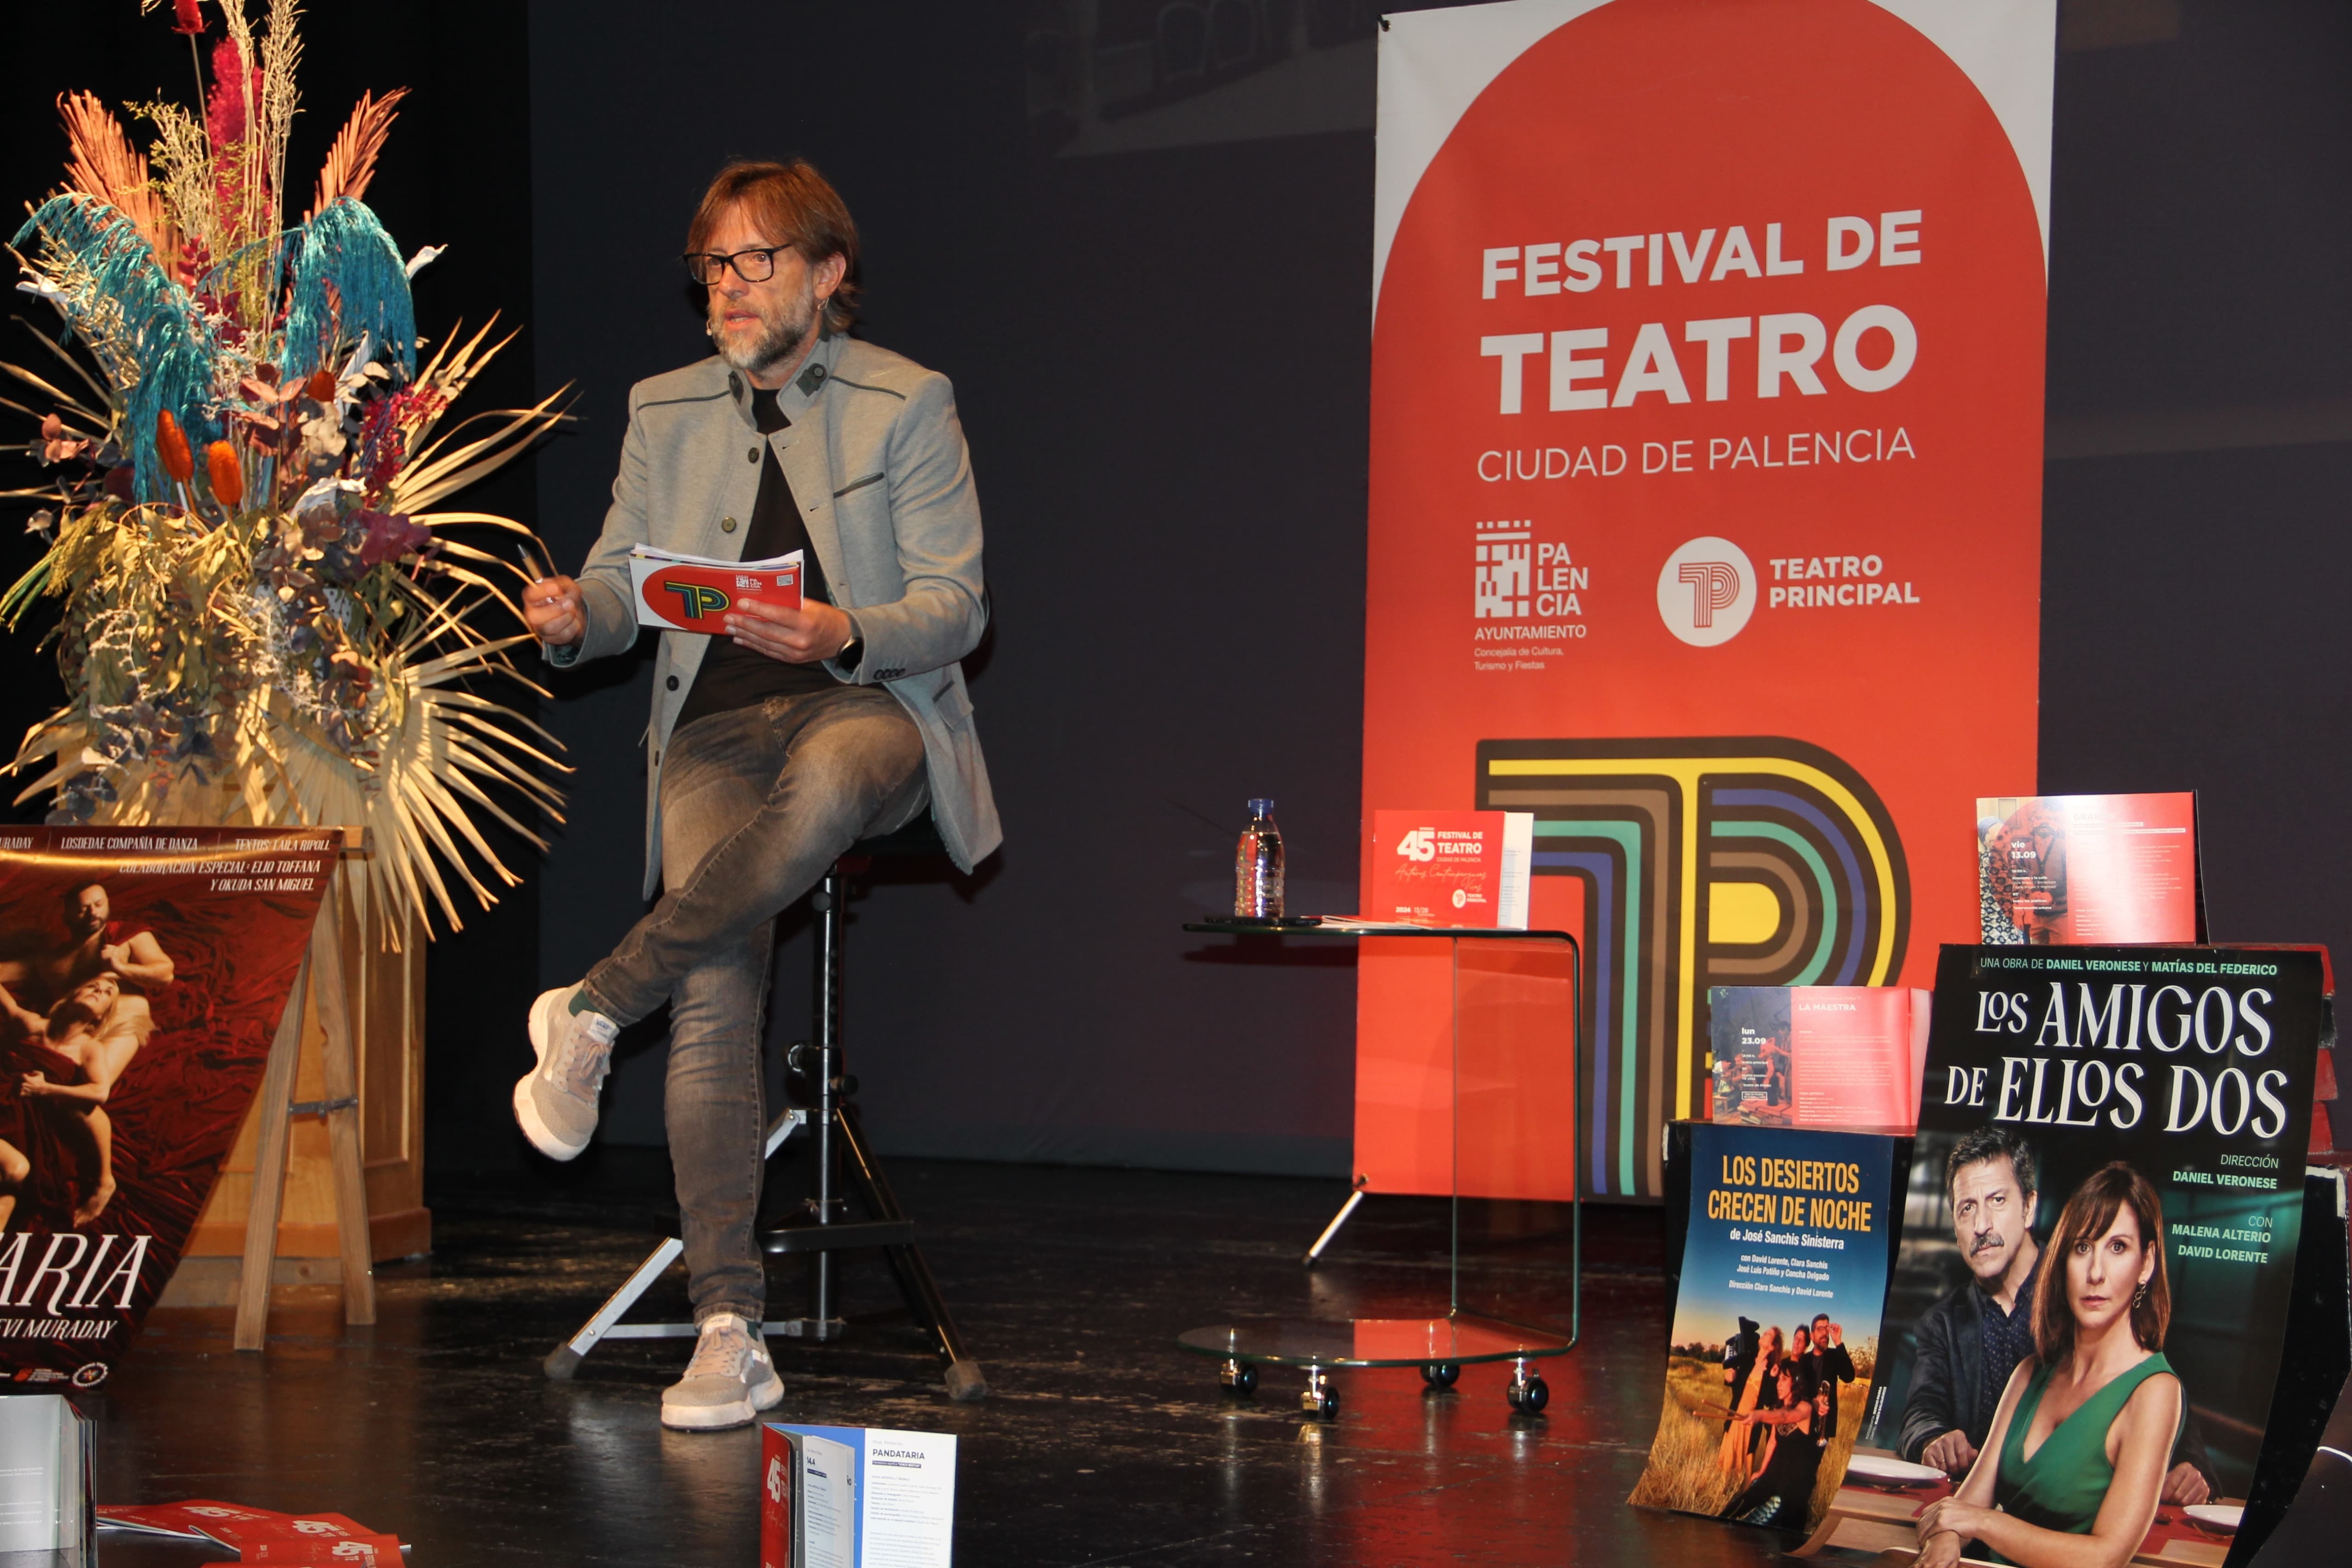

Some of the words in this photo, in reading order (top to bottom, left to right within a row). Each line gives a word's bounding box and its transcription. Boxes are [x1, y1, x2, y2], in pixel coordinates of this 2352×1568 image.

[1482, 222, 1804, 299] FESTIVAL
[1826, 209, 1922, 271] DE
[1480, 304, 1917, 414] TEATRO
[1477, 445, 1627, 481] CIUDAD
[1643, 440, 1693, 474] DE
[1709, 427, 1916, 469] PALENCIA
[1538, 543, 1571, 566] PA
[1770, 555, 1883, 580] TEATRO
[1538, 567, 1588, 591] LEN
[1770, 582, 1920, 608] PRINCIPAL
[1536, 593, 1582, 617] CIA
[1475, 624, 1586, 640] AYUNTAMIENTO
[1474, 647, 1516, 658] Concejalía
[1518, 647, 1529, 656] de
[1475, 661, 1506, 670] Turismo
[1508, 662, 1513, 671] y
[1515, 660, 1545, 669] Fiestas
[61, 837, 106, 850] LOSDEDAE
[107, 836, 153, 850] COMPAÑÍA
[155, 838, 166, 850] DE
[169, 838, 198, 850] DANZA
[235, 838, 272, 850] TEXTOS:
[300, 839, 330, 851] RIPOLL
[1396, 830, 1435, 862] 45
[1437, 843, 1482, 854] TEATRO
[251, 861, 275, 873] ELIO
[277, 860, 321, 873] TOFFANA
[210, 879, 219, 892] Y
[218, 878, 252, 891] OKUDA
[254, 878, 276, 891] SAN
[277, 878, 314, 890] MIGUEL
[1980, 958, 2000, 968] UNA
[2002, 958, 2028, 968] OBRA
[2031, 959, 2044, 969] DE
[2047, 959, 2083, 970] DANIEL
[2086, 960, 2141, 971] VERONESE
[2143, 962, 2149, 972] Y
[2152, 959, 2194, 973] MATÍAS
[2196, 962, 2217, 974] DEL
[2220, 963, 2277, 975] FEDERICO
[1975, 991, 2029, 1034] LOS
[2034, 982, 2272, 1056] AMIGOS
[1741, 1026, 1755, 1035] lun
[1944, 1066, 1988, 1107] DE
[1994, 1056, 2145, 1130] ELLOS
[2163, 1065, 2289, 1139] DOS
[2221, 1154, 2279, 1169] DIRECCIÓN
[1722, 1155, 1756, 1186] LOS
[1761, 1158, 1860, 1194] DESIERTOS
[2173, 1171, 2214, 1184] DANIEL
[2216, 1174, 2277, 1189] VERONESE
[1708, 1189, 1776, 1223] CRECEN
[1781, 1195, 1805, 1227] DE
[1809, 1198, 1872, 1232] NOCHE
[2249, 1216, 2273, 1228] CON
[1730, 1228, 1741, 1240] de
[1742, 1228, 1763, 1243] José
[1764, 1230, 1799, 1246] Sanchis
[1801, 1234, 1844, 1250] Sinisterra
[2172, 1224, 2220, 1239] MALENA
[2222, 1228, 2271, 1243] ALTERIO
[1752, 1254, 1767, 1263] David
[1768, 1256, 1790, 1267] Lorente,
[1791, 1258, 1805, 1267] Clara
[1806, 1259, 1828, 1269] Sanchis
[2178, 1245, 2213, 1258] DAVID
[2215, 1248, 2268, 1264] LORENTE
[0, 1232, 152, 1316] ARIA
[1736, 1264, 1750, 1273] José
[1751, 1265, 1762, 1274] Luis
[1763, 1266, 1780, 1276] Patiño
[1781, 1269, 1784, 1278] y
[1785, 1269, 1806, 1279] Concha
[1807, 1271, 1829, 1281] Delgado
[1729, 1280, 1753, 1290] Dirección
[1754, 1282, 1768, 1291] Clara
[1769, 1284, 1790, 1294] Sanchis
[1791, 1287, 1795, 1296] y
[1796, 1287, 1812, 1296] David
[1812, 1289, 1834, 1298] Lorente
[23, 1319, 118, 1340] MURADAY
[873, 1449, 925, 1460] PANDATARIA
[767, 1457, 781, 1503] 45
